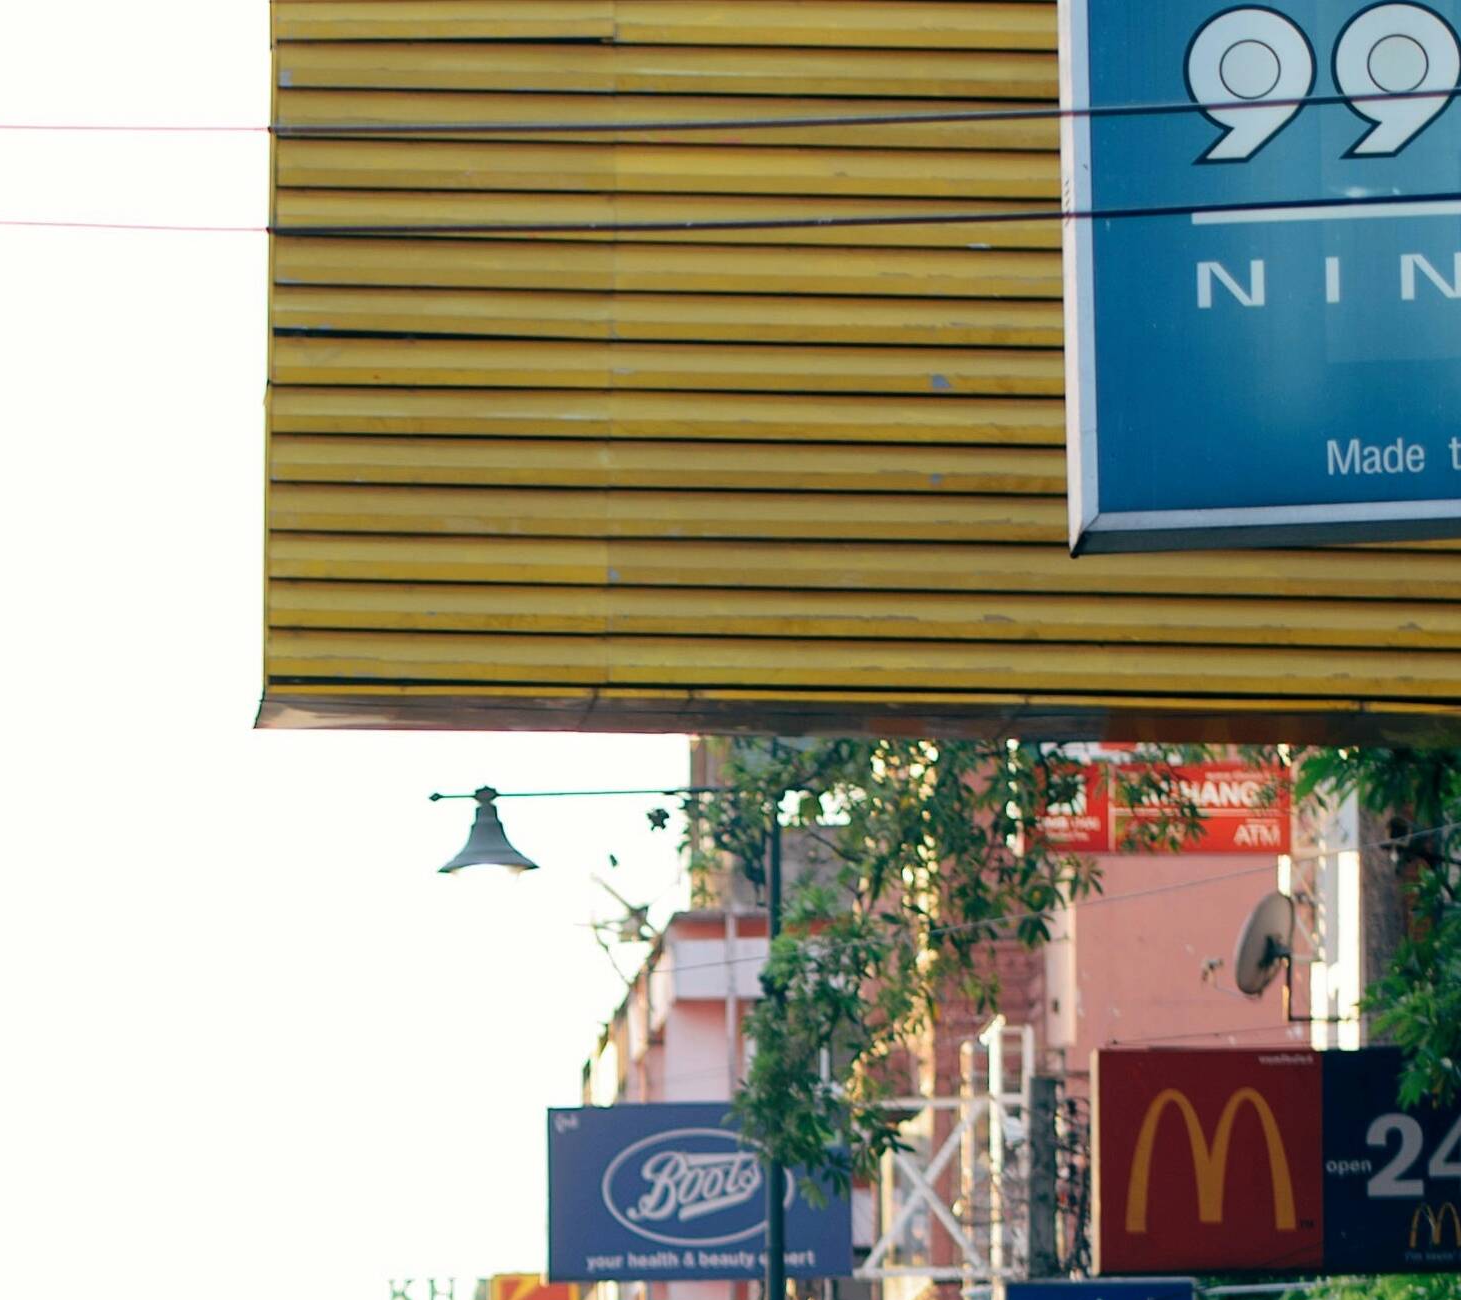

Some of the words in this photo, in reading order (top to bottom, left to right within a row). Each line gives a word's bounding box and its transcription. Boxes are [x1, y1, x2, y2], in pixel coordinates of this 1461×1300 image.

[1326, 438, 1427, 476] Made
[1233, 824, 1280, 847] ATM
[1325, 1157, 1373, 1176] open
[626, 1150, 763, 1222] Boots
[586, 1253, 624, 1272] your
[628, 1249, 679, 1268] health
[682, 1250, 694, 1268] &
[698, 1249, 754, 1271] beauty
